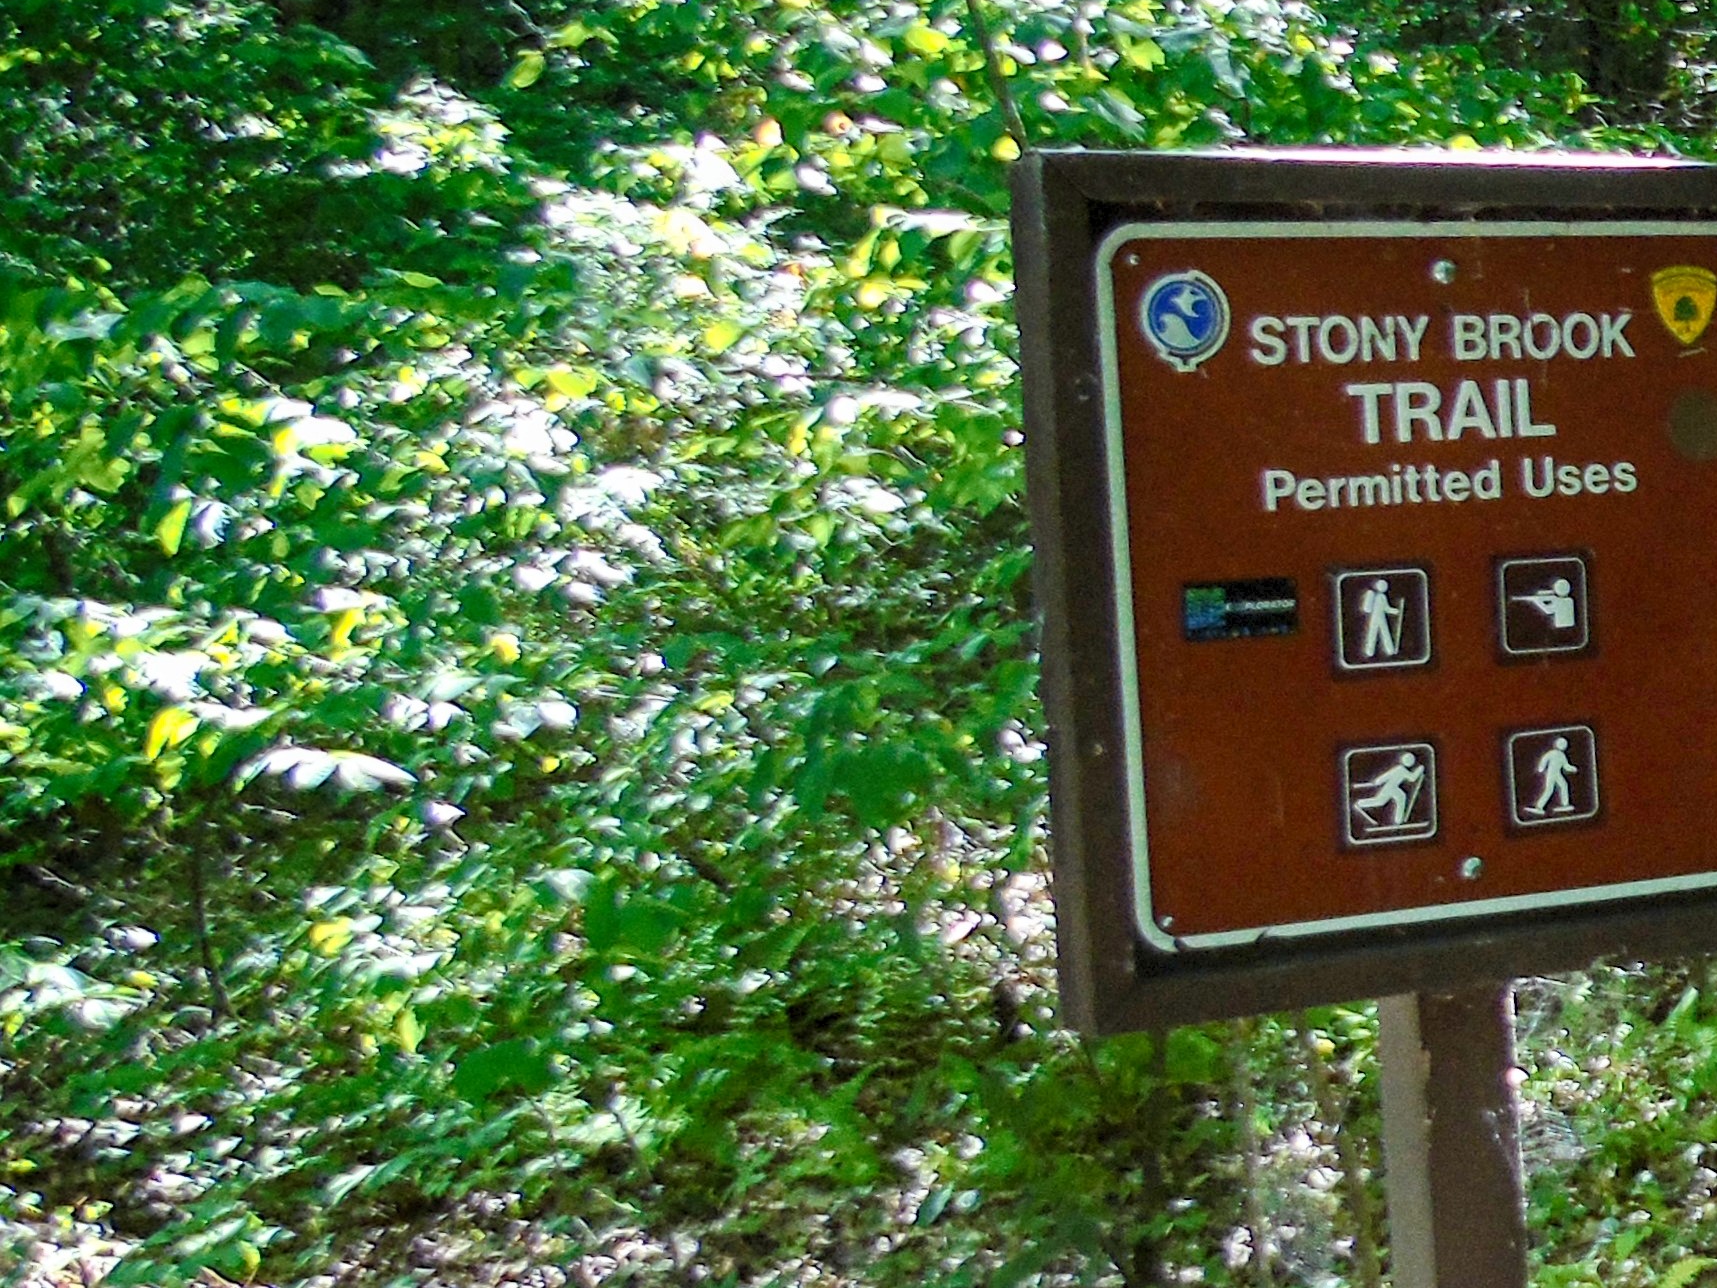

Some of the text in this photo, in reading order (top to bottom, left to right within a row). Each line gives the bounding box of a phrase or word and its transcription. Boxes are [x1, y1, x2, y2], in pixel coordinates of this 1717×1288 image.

[1250, 311, 1636, 366] STONY BROOK
[1345, 377, 1557, 445] TRAIL
[1263, 455, 1638, 511] Permitted Uses
